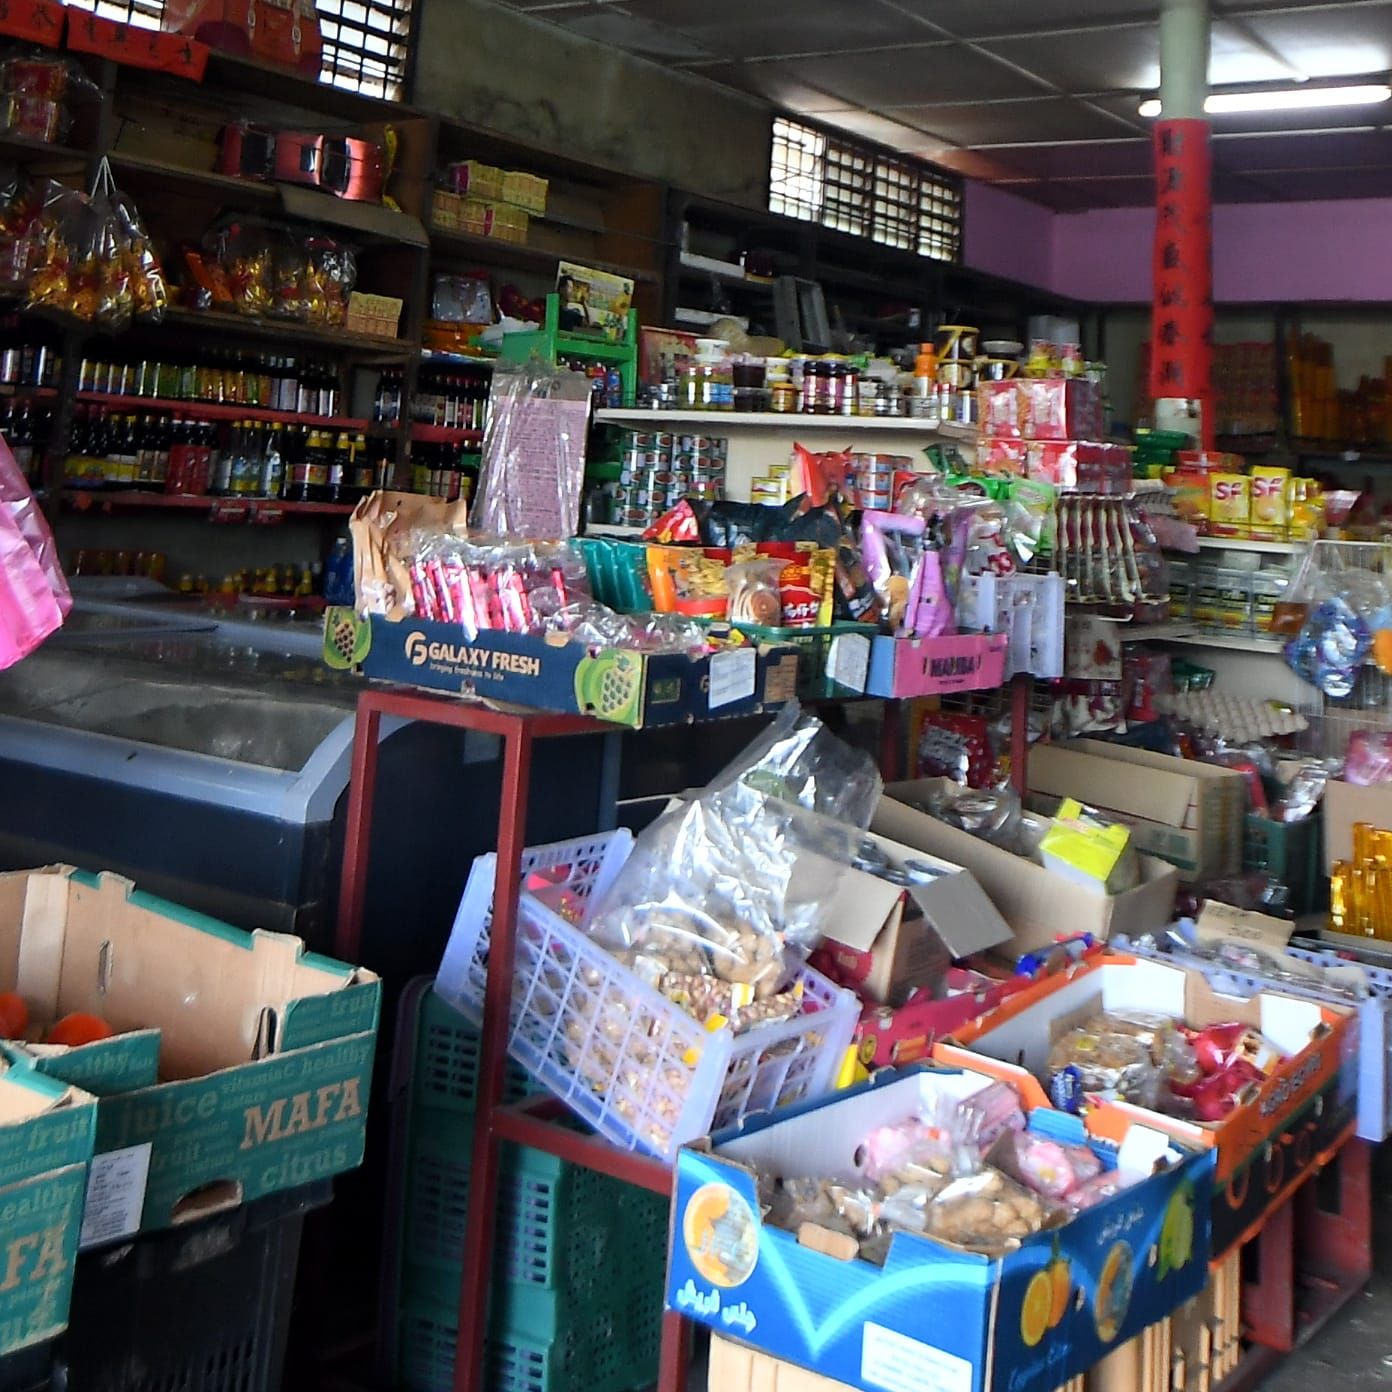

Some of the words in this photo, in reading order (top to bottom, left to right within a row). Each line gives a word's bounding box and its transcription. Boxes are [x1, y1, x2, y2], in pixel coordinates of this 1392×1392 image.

[428, 641, 491, 669] GALAXY
[491, 651, 541, 677] FRESH
[240, 1075, 362, 1151] MAFA
